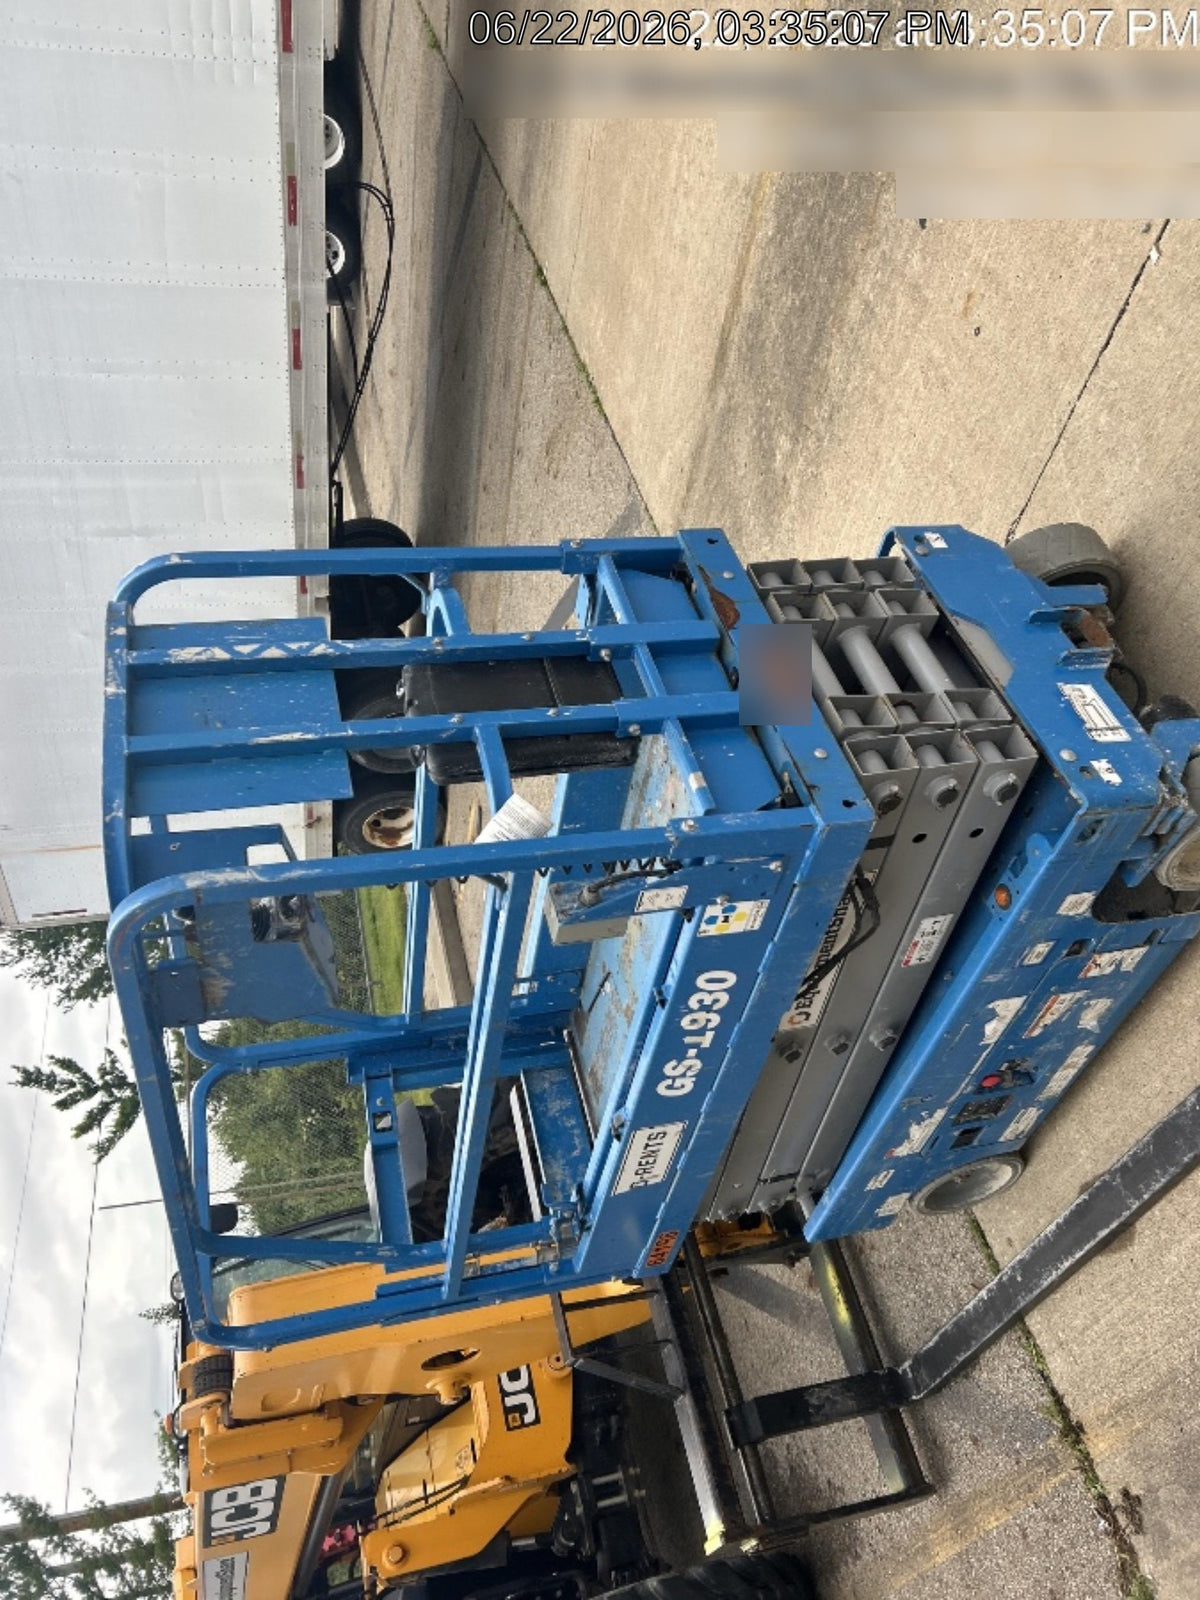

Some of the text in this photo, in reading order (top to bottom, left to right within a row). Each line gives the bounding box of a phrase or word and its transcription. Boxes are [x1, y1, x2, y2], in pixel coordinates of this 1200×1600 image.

[656, 970, 737, 1097] GS-1930
[499, 1364, 536, 1425] JC
[211, 1478, 278, 1538] JCB
